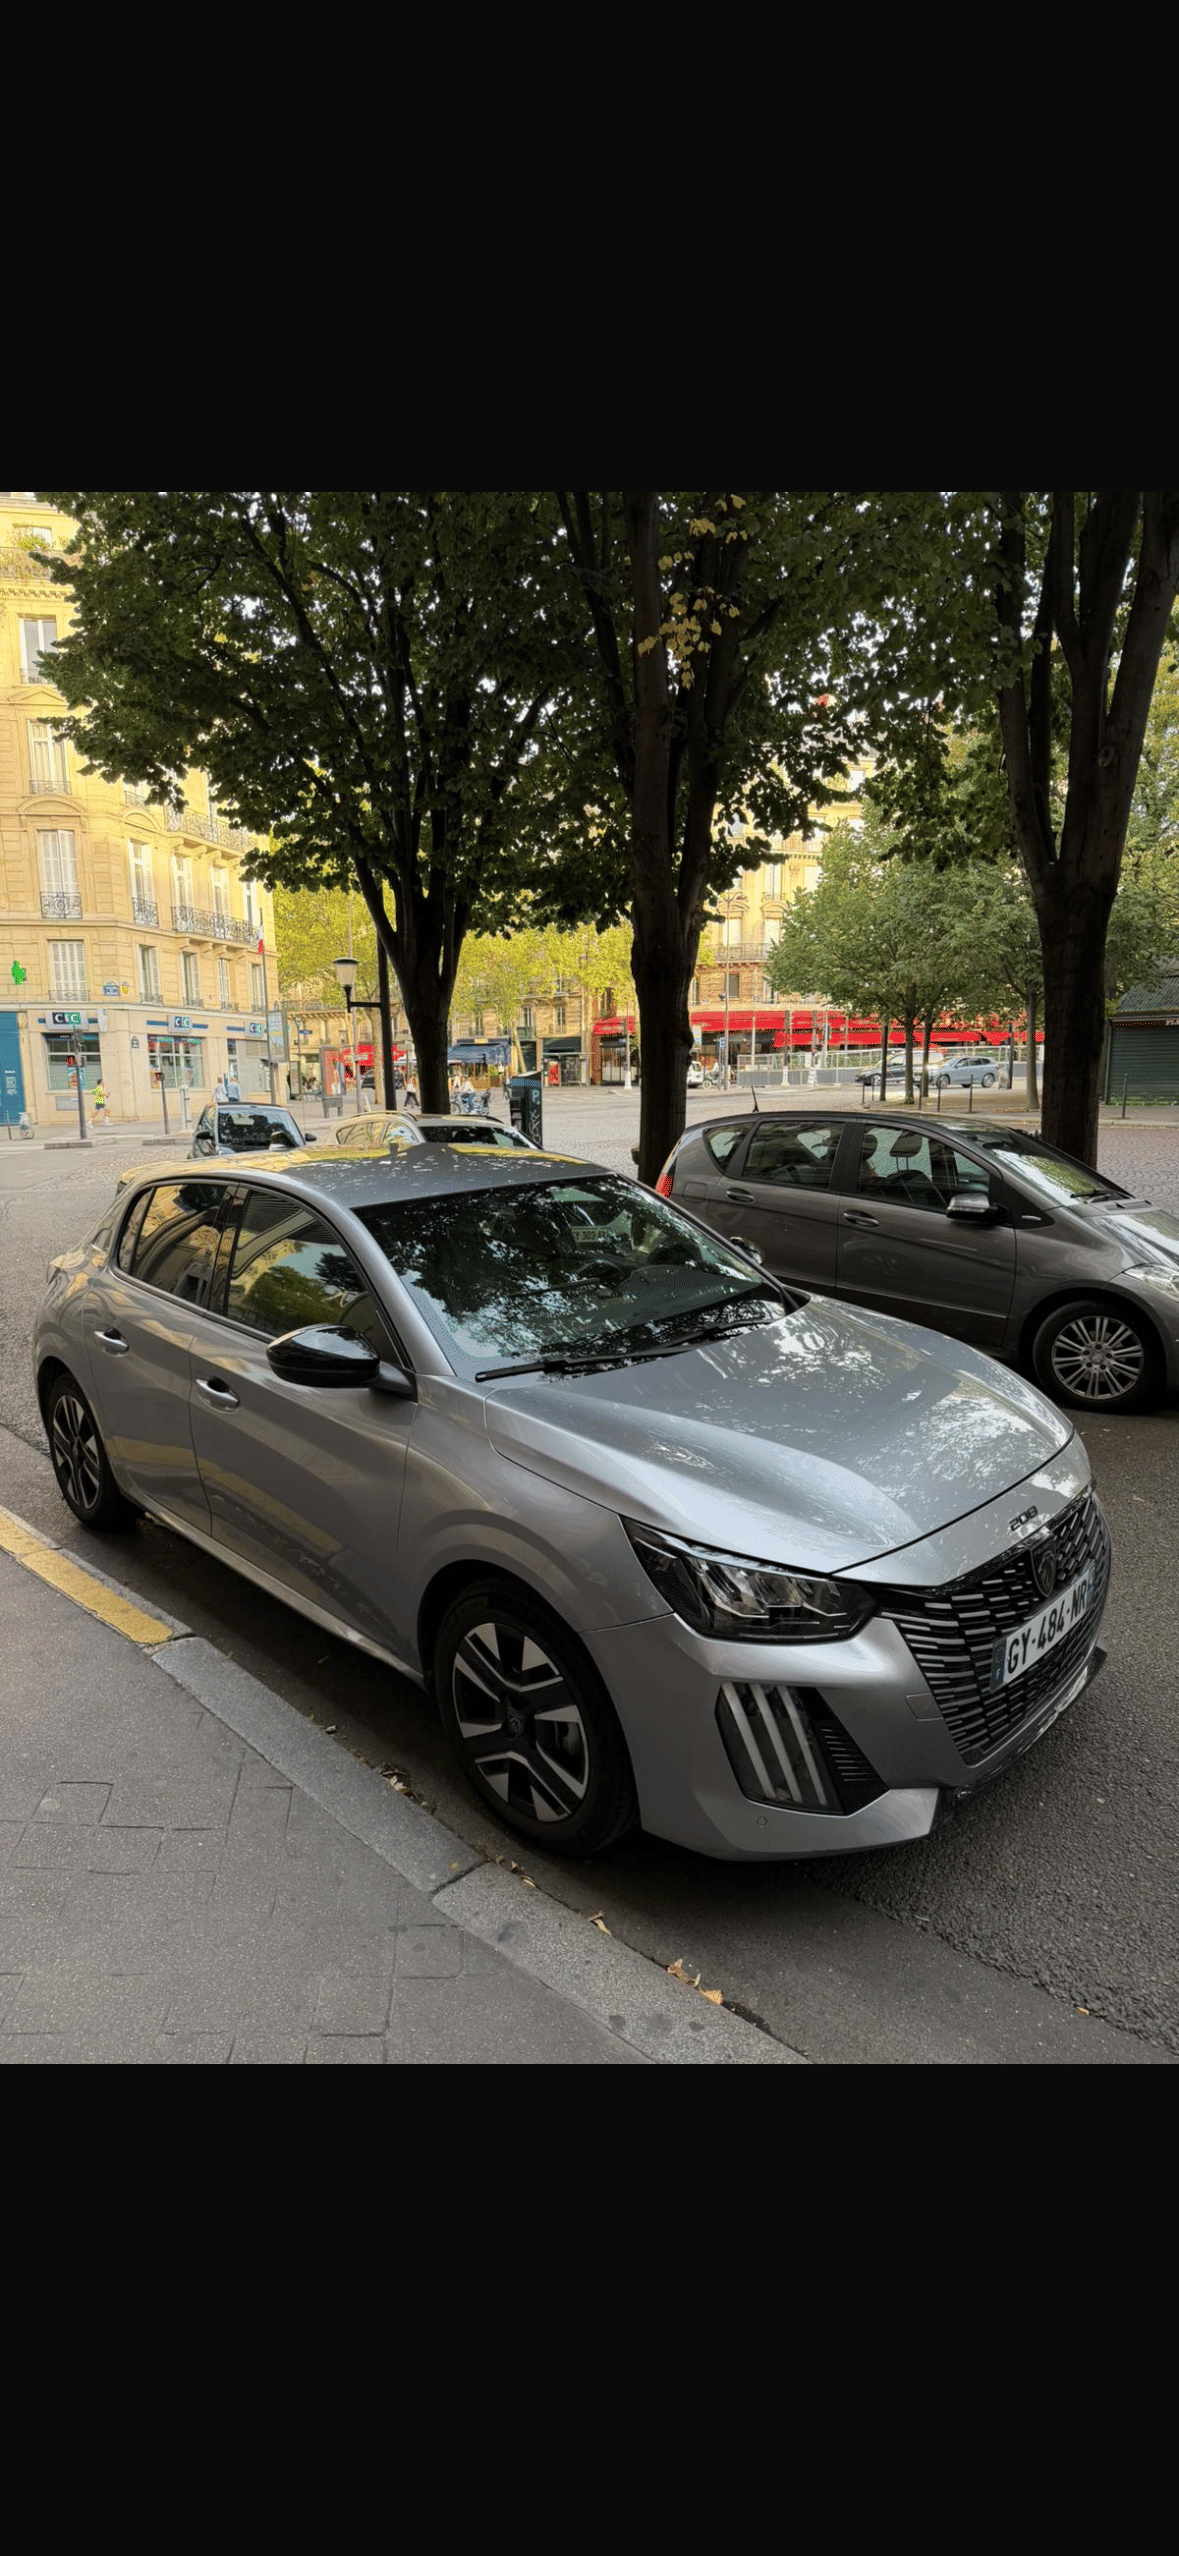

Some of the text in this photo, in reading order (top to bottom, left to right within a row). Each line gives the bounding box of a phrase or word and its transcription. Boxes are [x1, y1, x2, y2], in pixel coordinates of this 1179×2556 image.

[53, 1013, 80, 1023] CIC
[532, 1089, 539, 1102] P
[1009, 1505, 1038, 1531] 208
[1008, 1579, 1087, 1674] GY-484-NR
